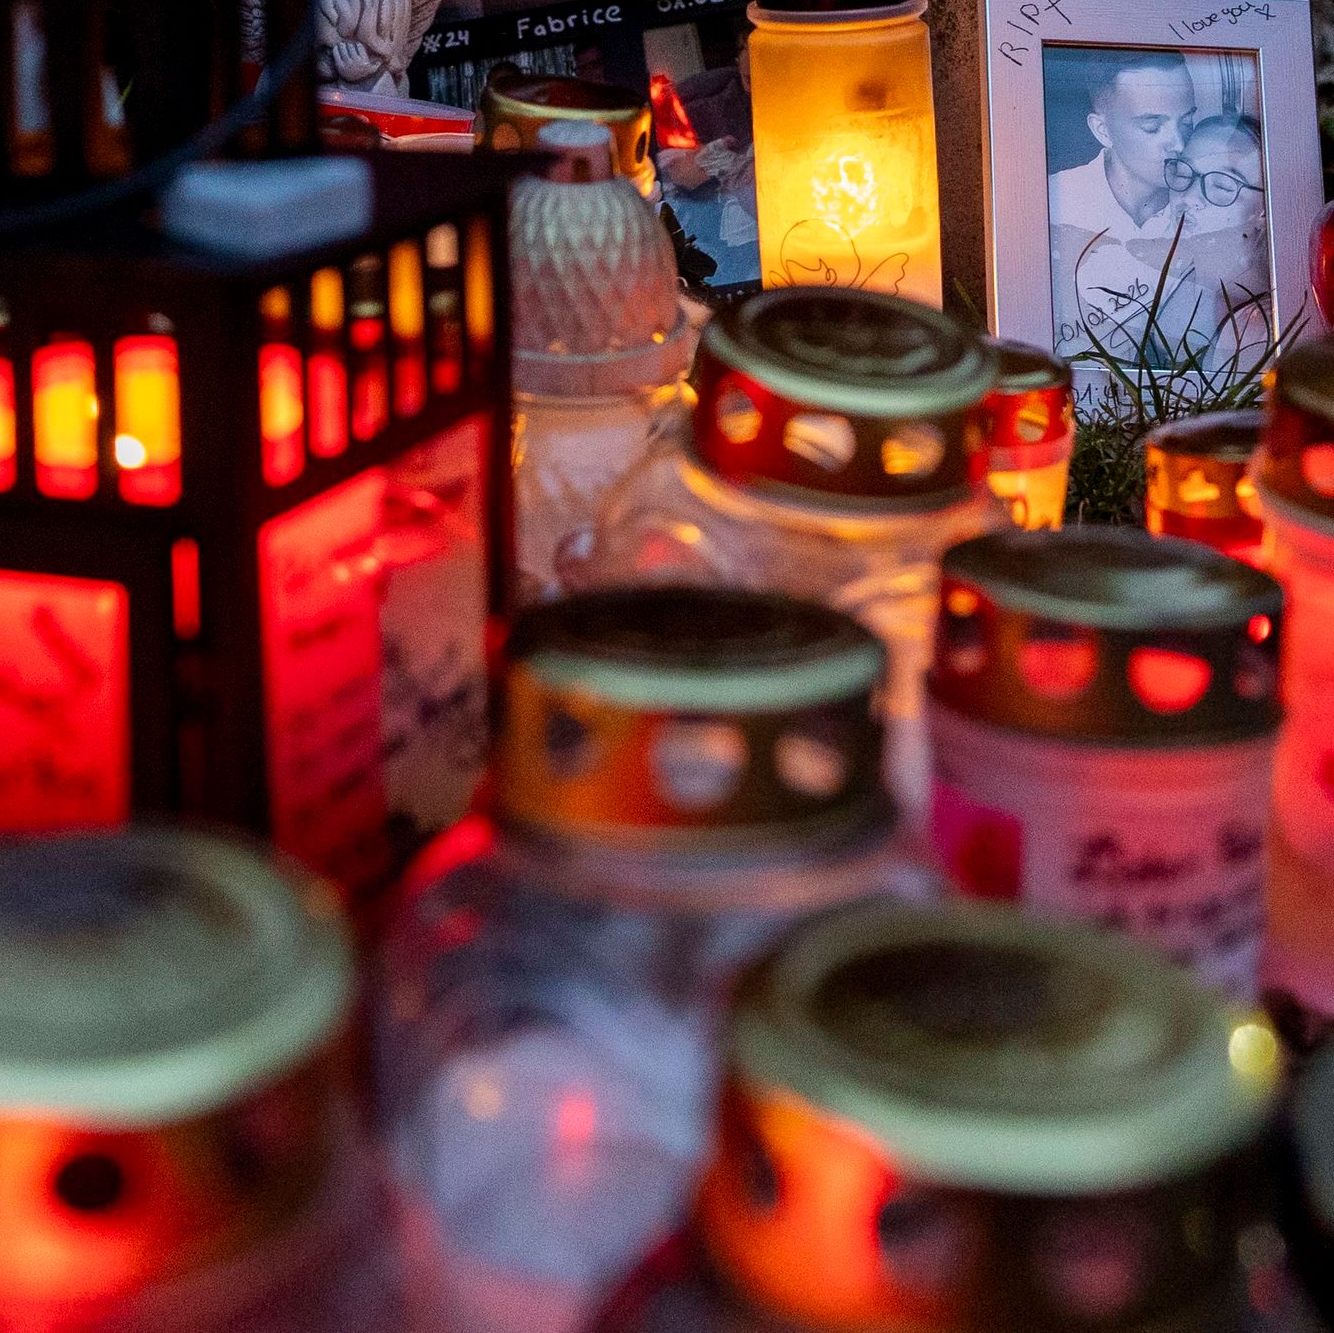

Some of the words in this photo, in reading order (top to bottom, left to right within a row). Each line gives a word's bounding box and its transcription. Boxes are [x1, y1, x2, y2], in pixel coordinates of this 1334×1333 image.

[516, 4, 623, 40] Fabrice
[1182, 11, 1222, 35] love
[1222, 0, 1258, 25] you
